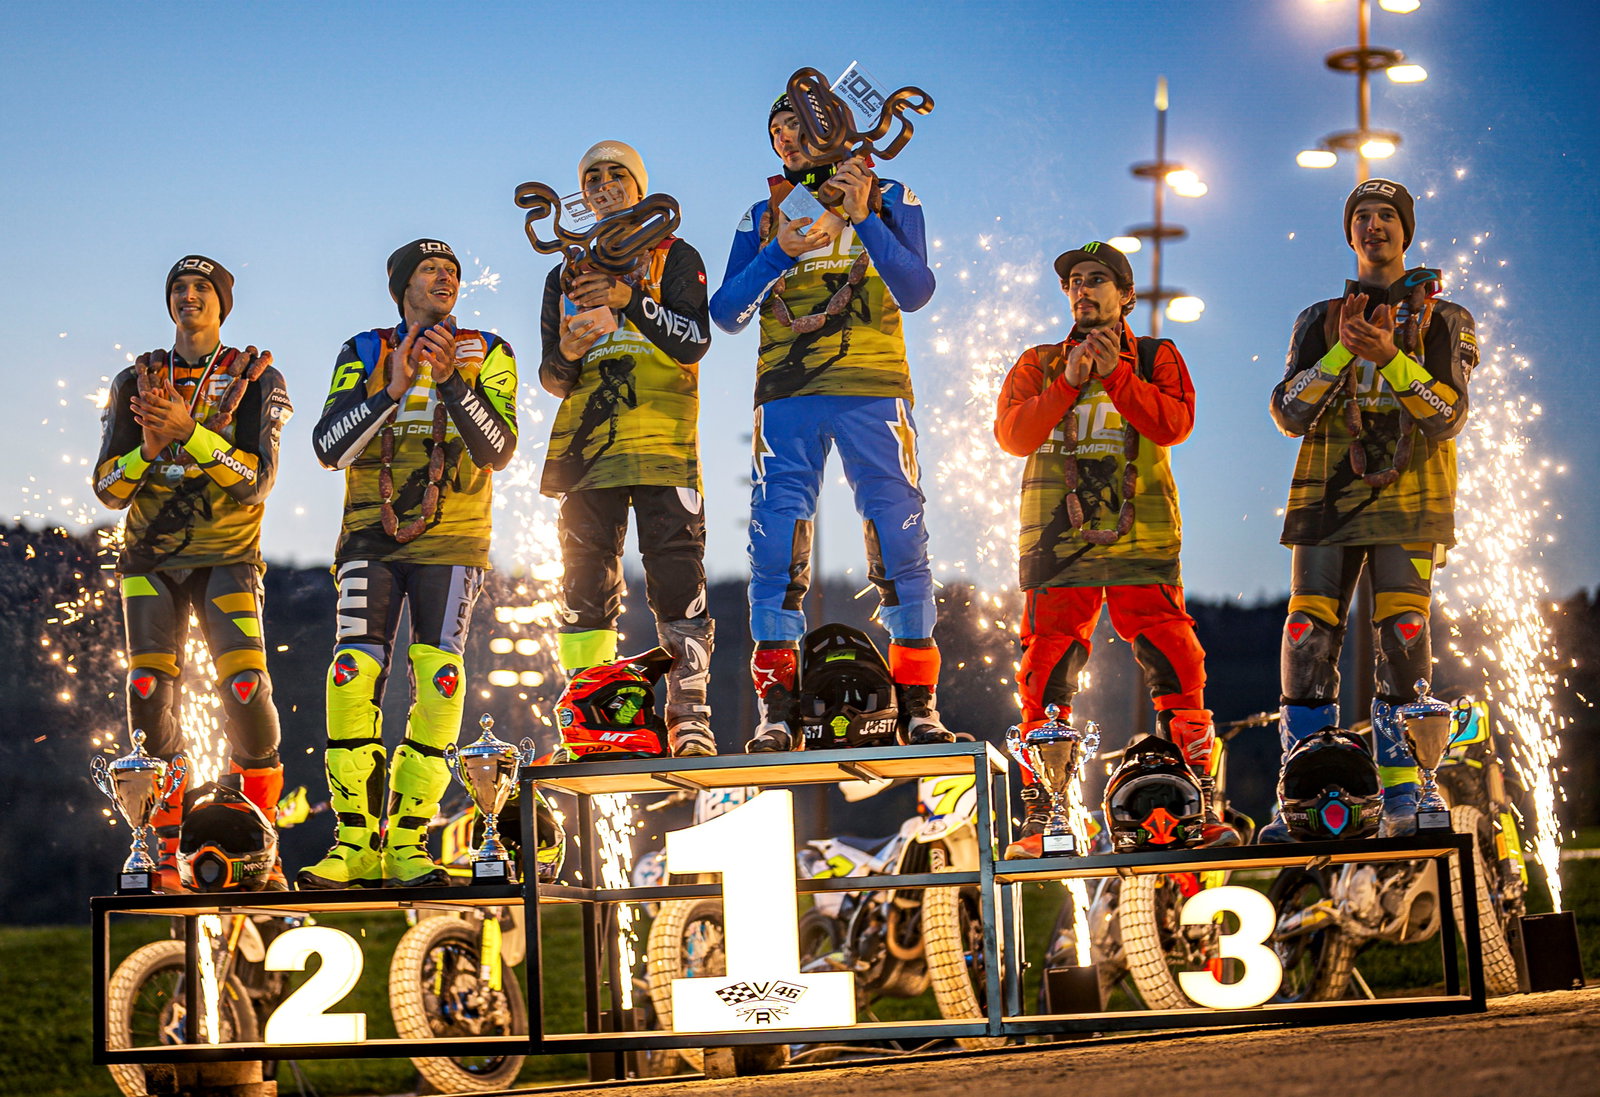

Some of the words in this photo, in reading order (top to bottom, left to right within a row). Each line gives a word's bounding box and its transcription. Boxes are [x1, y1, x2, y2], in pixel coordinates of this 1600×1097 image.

[318, 402, 372, 453] YAMAHA
[460, 388, 506, 454] YAMAHA
[599, 732, 640, 743] MT
[665, 788, 857, 1033] 1
[1178, 885, 1283, 1010] 3
[264, 926, 367, 1045] 2
[775, 986, 800, 999] 46
[756, 1012, 771, 1024] R
